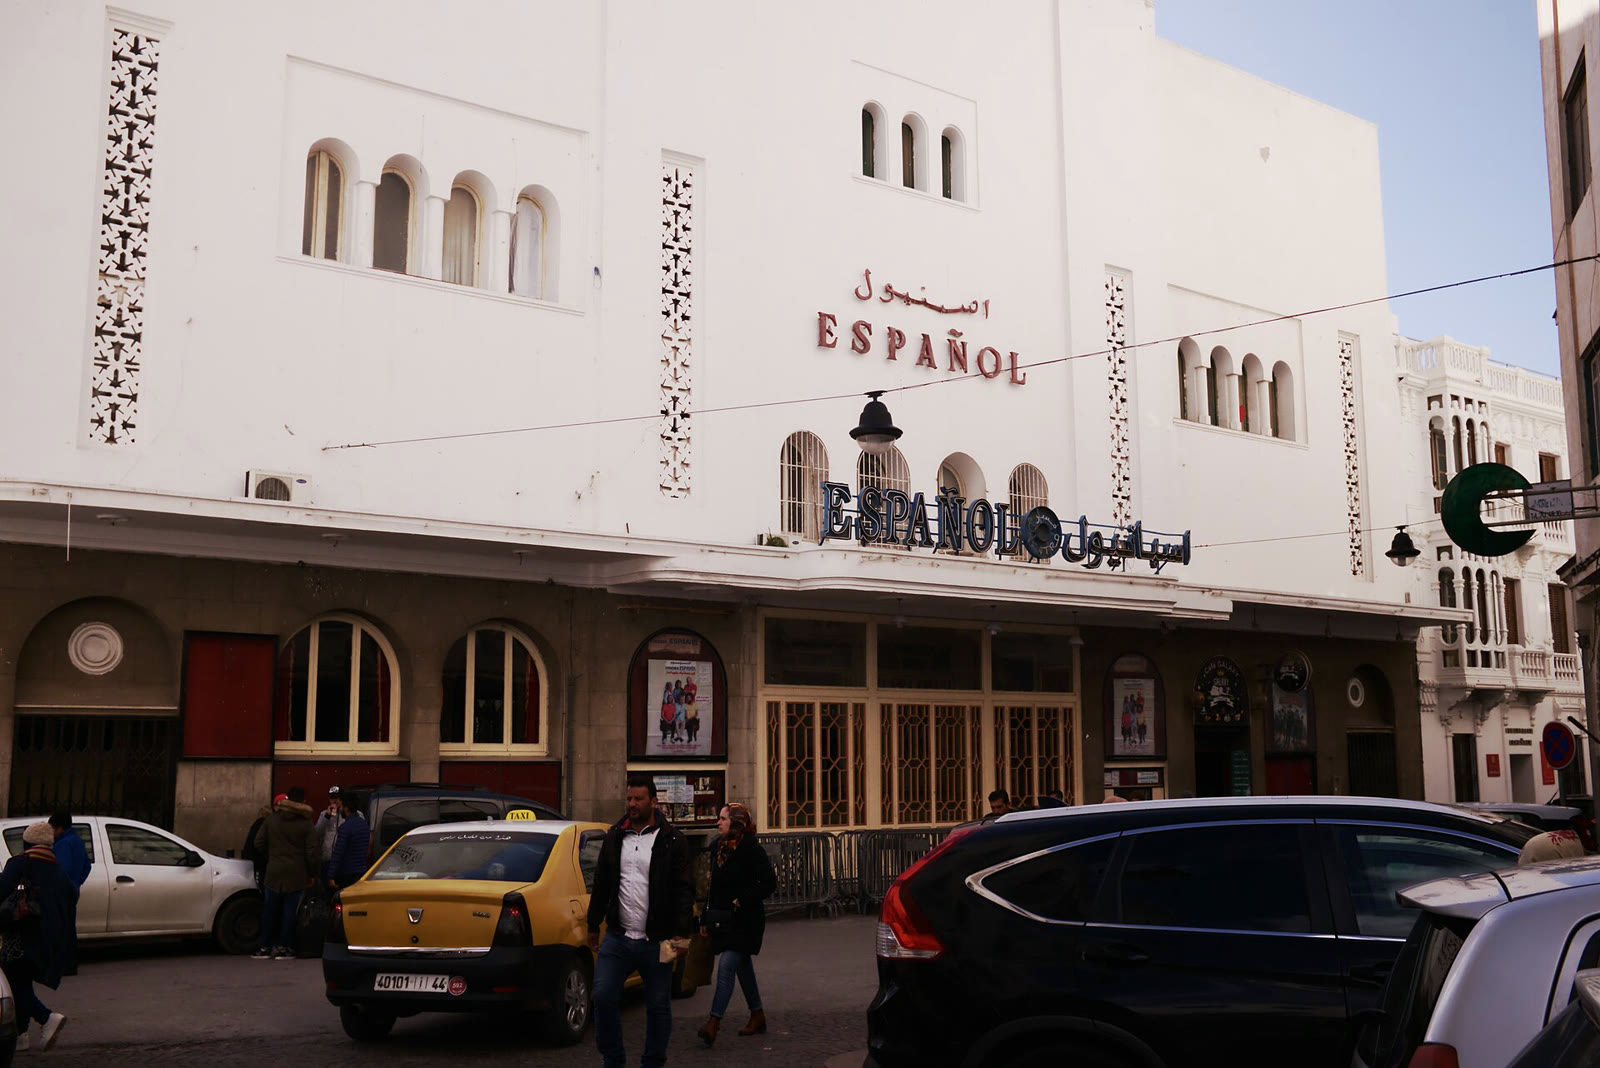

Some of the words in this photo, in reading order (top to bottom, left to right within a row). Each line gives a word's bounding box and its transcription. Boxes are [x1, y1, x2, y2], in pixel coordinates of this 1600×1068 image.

[817, 311, 1026, 385] ESPAÑOL
[820, 480, 1020, 556] ESPAÑOL
[509, 812, 529, 820] TAXI
[377, 976, 410, 989] 40101
[432, 977, 446, 990] 44
